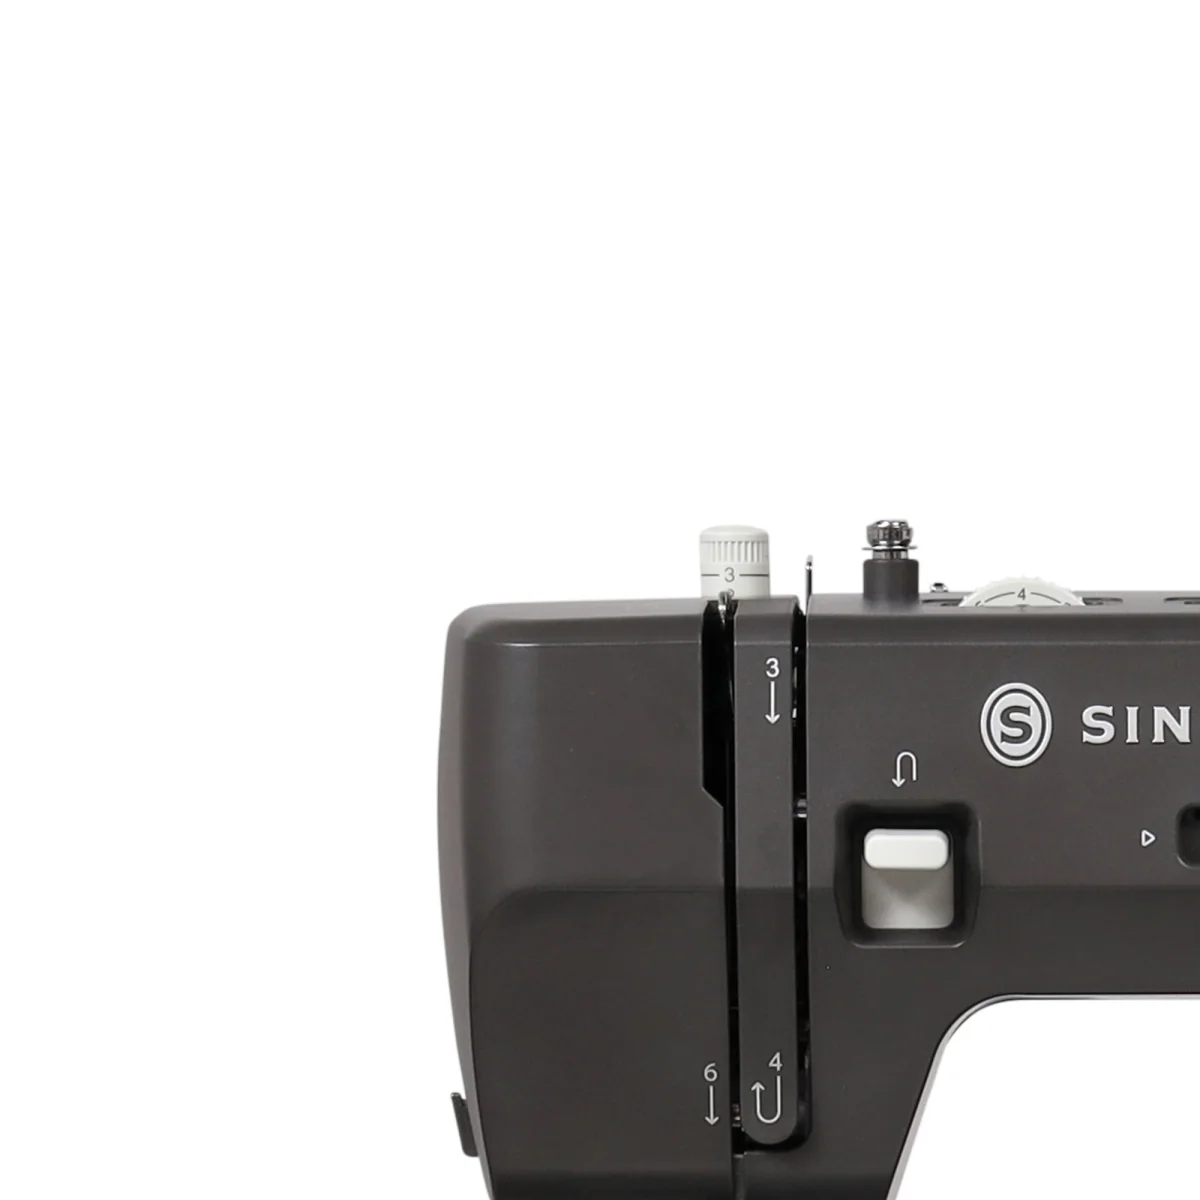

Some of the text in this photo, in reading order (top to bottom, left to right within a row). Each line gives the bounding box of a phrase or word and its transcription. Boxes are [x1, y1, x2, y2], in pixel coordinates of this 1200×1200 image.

[724, 566, 736, 583] 3
[1017, 587, 1027, 601] 4
[765, 657, 780, 678] 3
[768, 1051, 784, 1072] 4
[703, 1062, 719, 1082] 6
